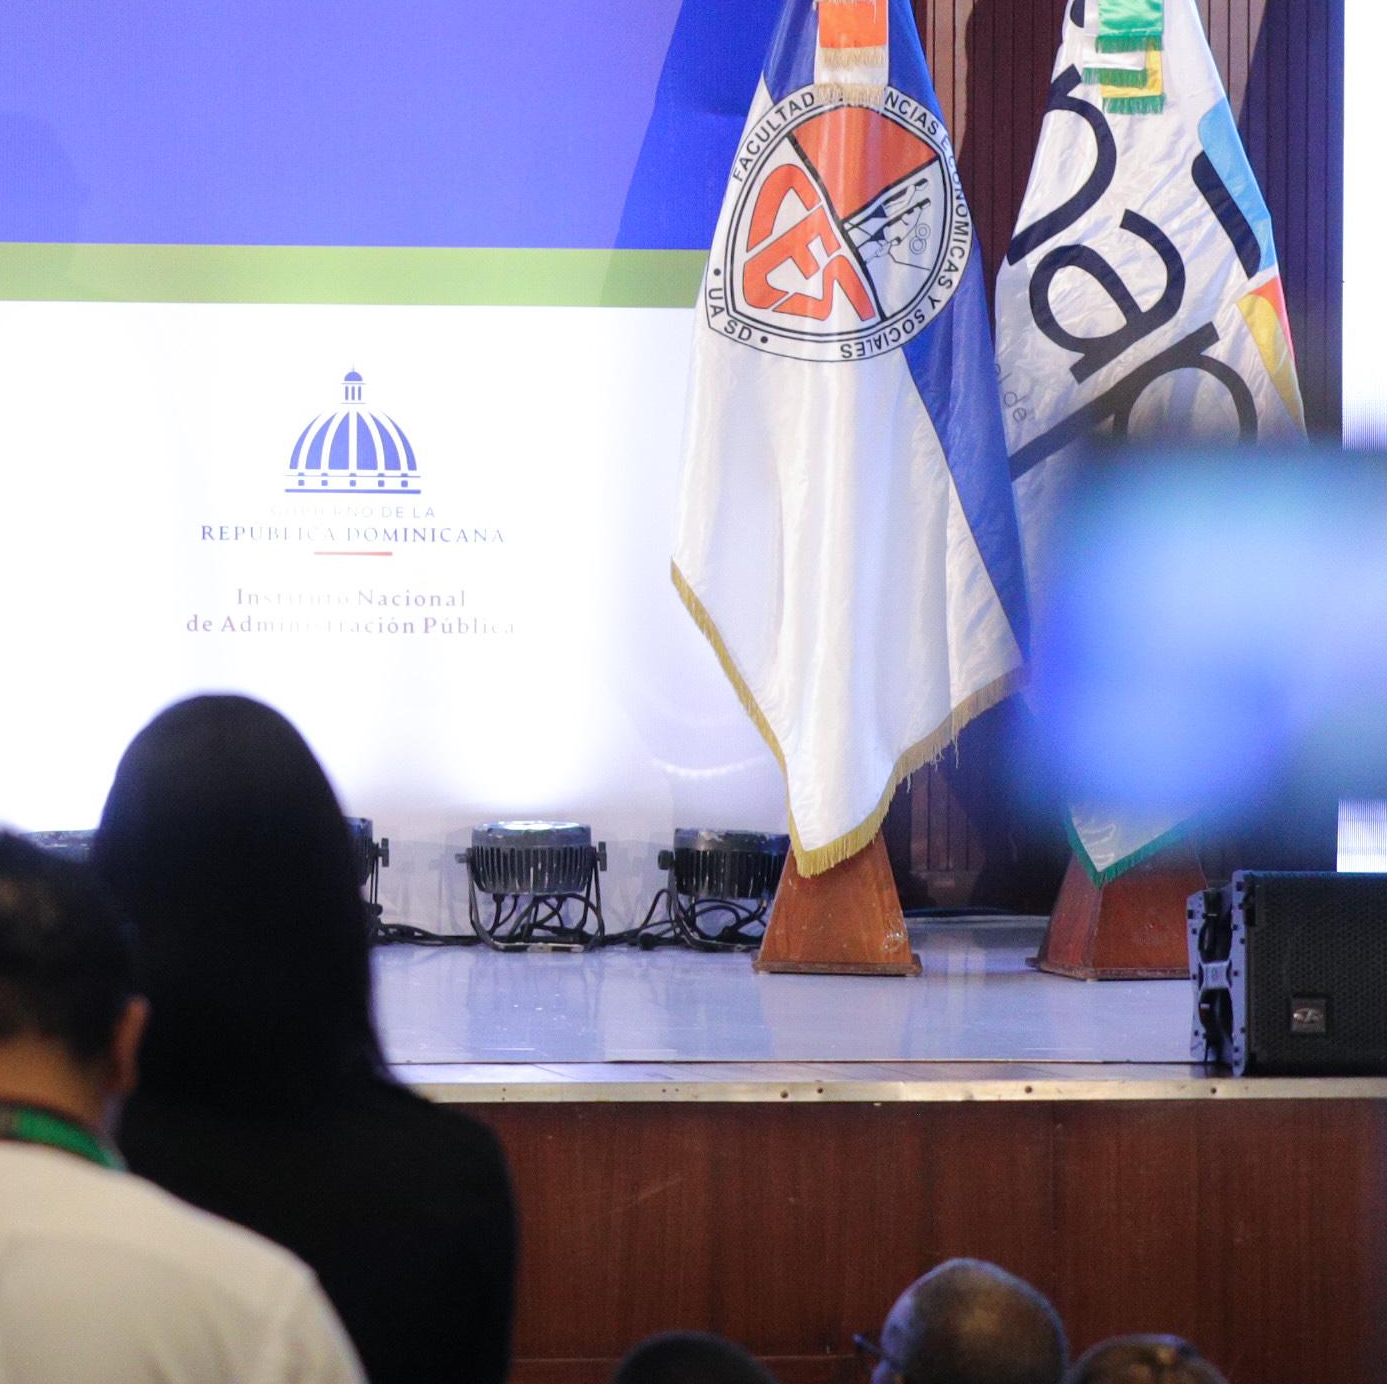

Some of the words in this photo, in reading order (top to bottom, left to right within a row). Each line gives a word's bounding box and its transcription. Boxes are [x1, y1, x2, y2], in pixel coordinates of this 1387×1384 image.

[883, 90, 939, 138] NCIAS
[733, 90, 815, 183] FACULTAD
[927, 295, 943, 311] Y
[840, 308, 926, 360] SOCIALES
[380, 506, 405, 519] DE
[412, 506, 436, 519] LA
[346, 527, 506, 544] DOMINICANA
[357, 589, 467, 609] Nacional
[185, 614, 214, 633] de
